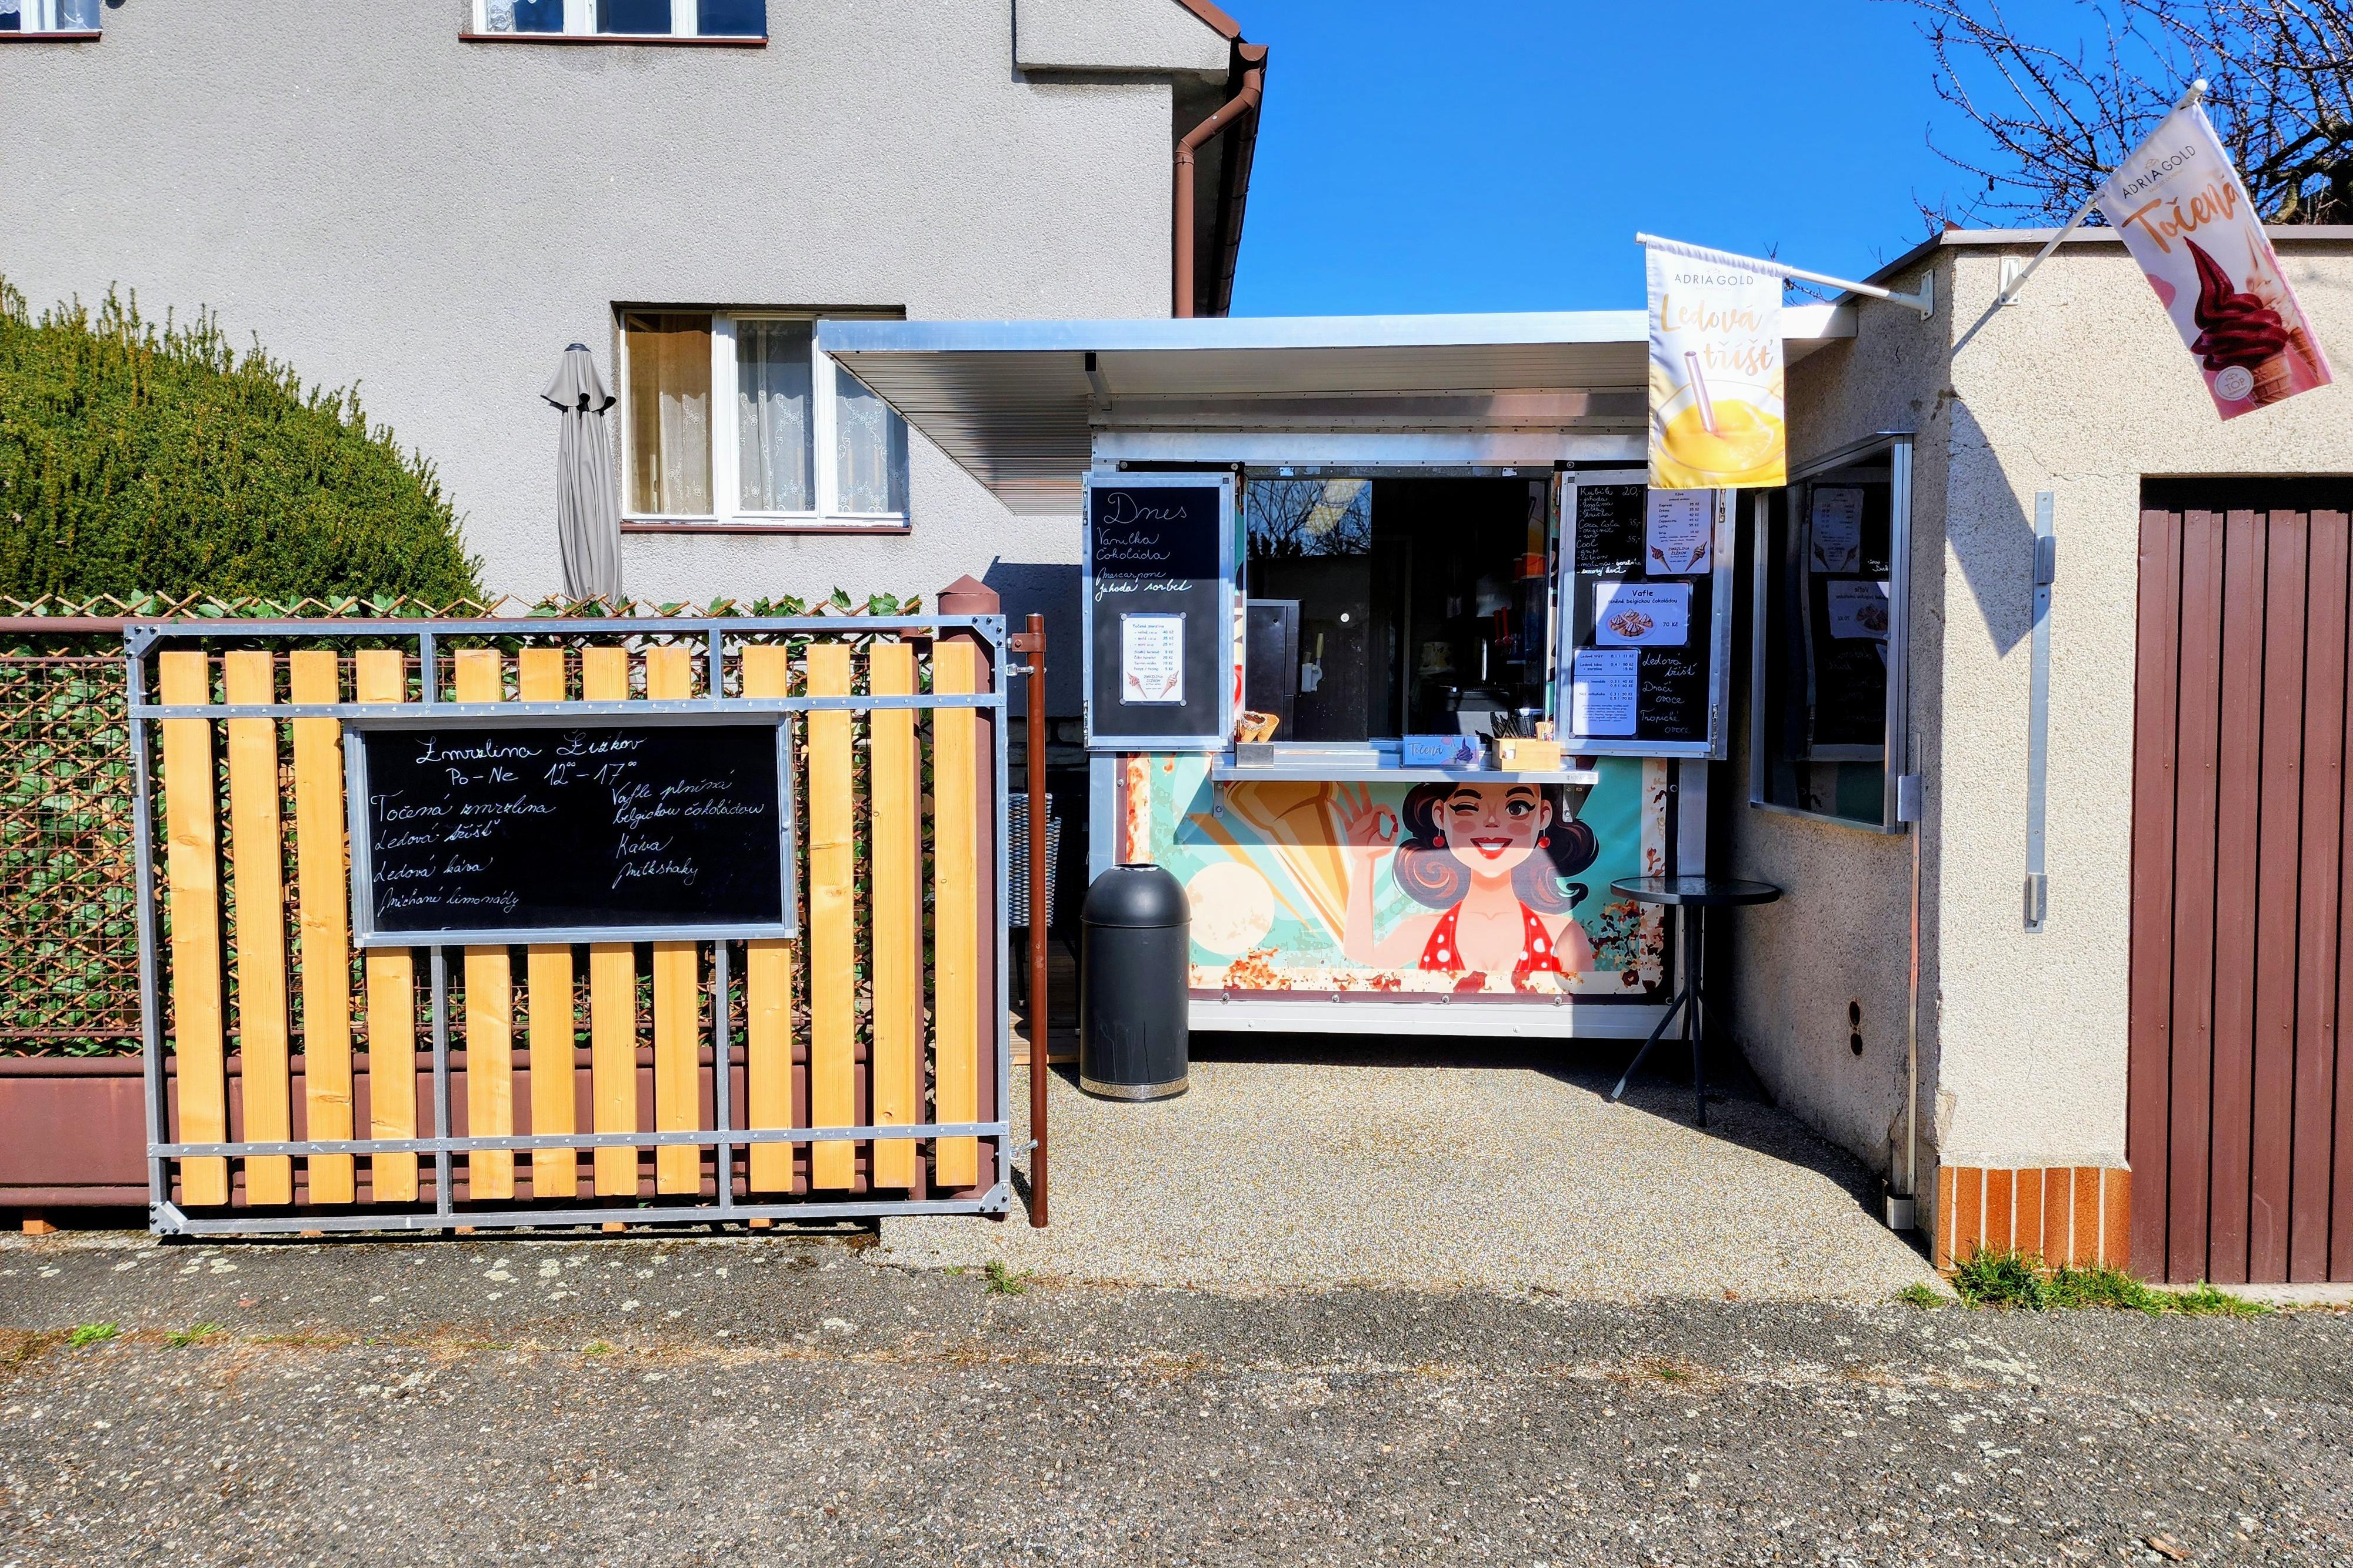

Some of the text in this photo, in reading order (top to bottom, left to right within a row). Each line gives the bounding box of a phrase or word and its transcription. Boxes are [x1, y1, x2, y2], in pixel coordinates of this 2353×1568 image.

[2122, 169, 2164, 199] ADRIA
[2161, 145, 2195, 171] GOLD
[2121, 174, 2240, 254] Točená
[1675, 273, 1754, 286] ADRIA GOLD
[1661, 293, 1762, 333] Ledová
[1703, 339, 1774, 376] tříšť
[2224, 378, 2245, 391] TOP
[1104, 492, 1187, 523] Dnes
[1096, 527, 1159, 545] Vanilka
[1578, 519, 1599, 529] Coca
[1096, 547, 1171, 560] Čokoláda
[1577, 539, 1598, 548] Cool
[1144, 579, 1192, 592] sorbet
[1642, 652, 1681, 666] Ledová
[1656, 696, 1685, 704] ovoce
[415, 729, 647, 763] Zmrzlina Žižkov
[1408, 742, 1444, 757] Točená
[371, 790, 556, 822] Točená zmrzlina
[612, 782, 652, 810] Vafle
[684, 799, 765, 816] čokoládou
[375, 822, 439, 850] Ledová
[616, 832, 673, 859] Káva
[374, 854, 493, 882] Ledová káva
[446, 886, 519, 913] limonády
